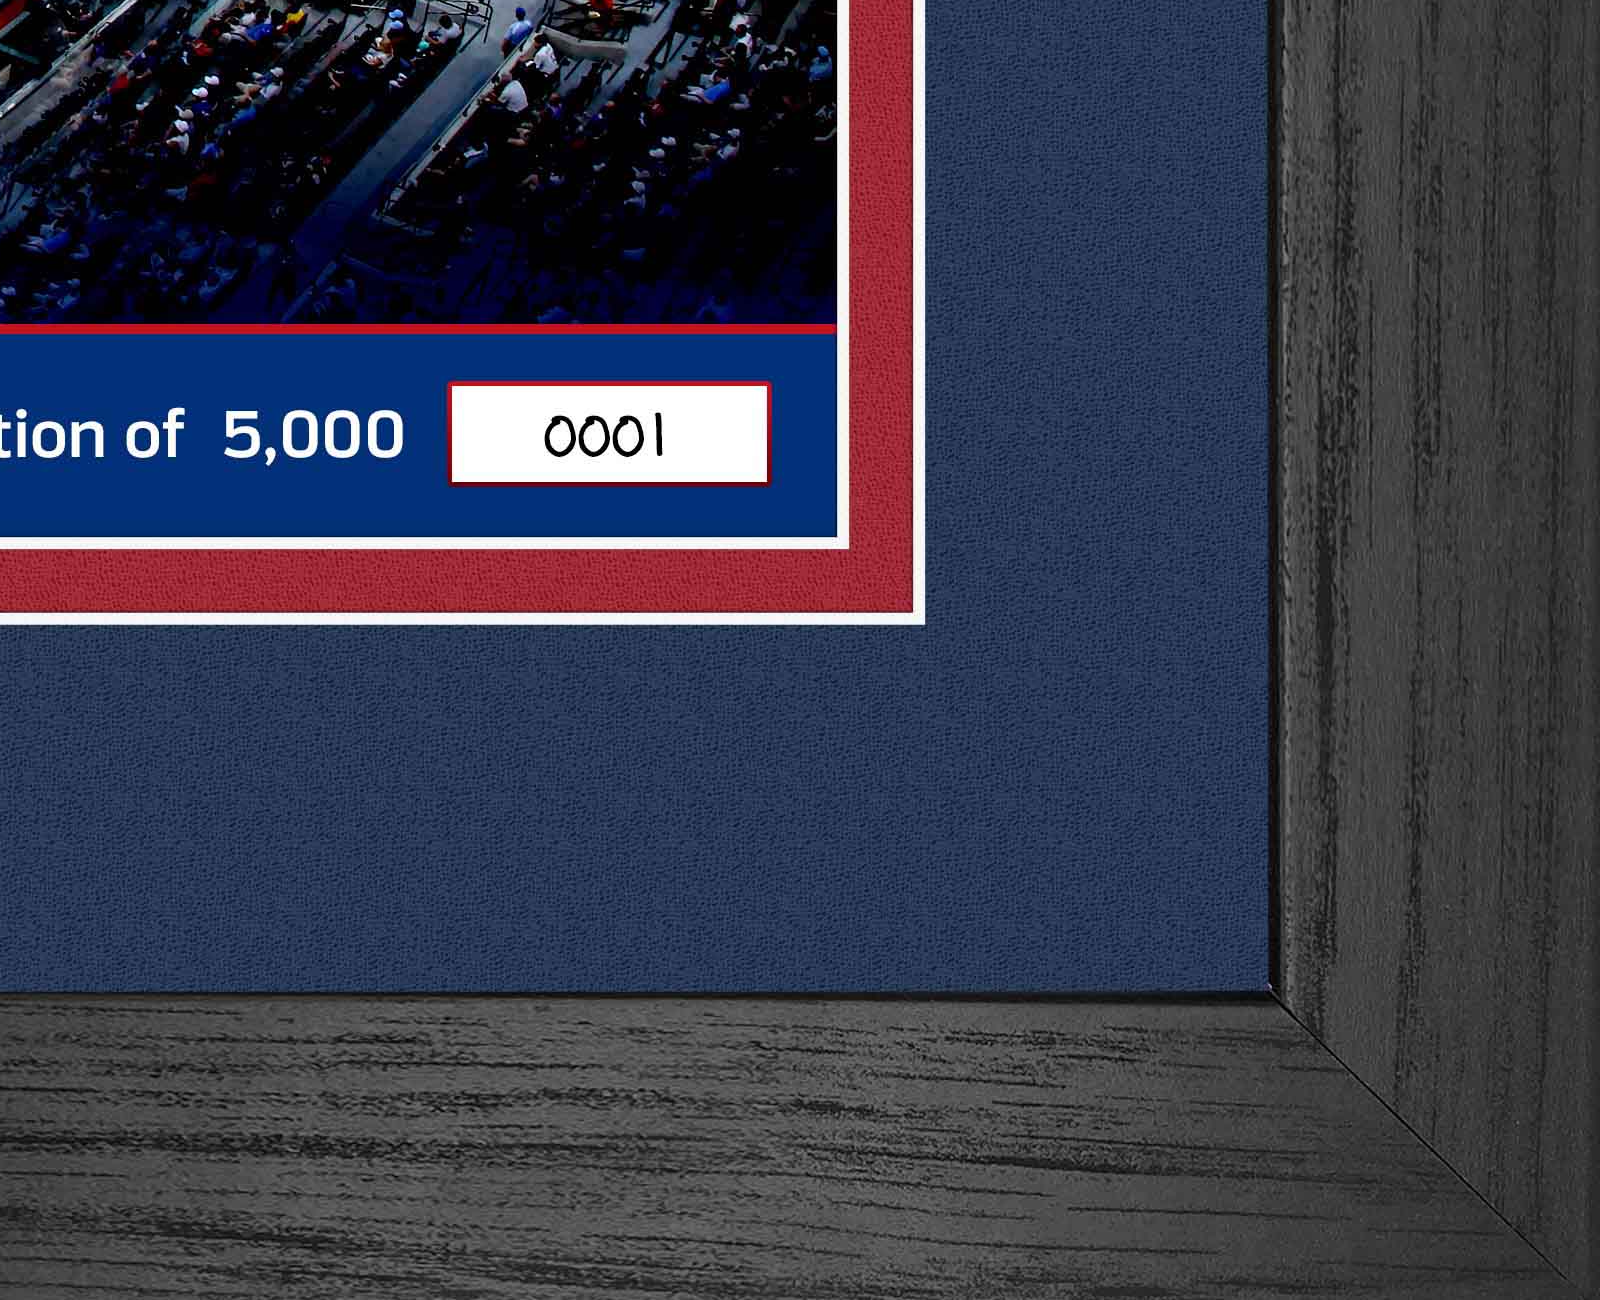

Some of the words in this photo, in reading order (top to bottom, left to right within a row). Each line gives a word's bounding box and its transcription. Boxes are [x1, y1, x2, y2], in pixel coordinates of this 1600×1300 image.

[126, 407, 185, 459] of
[224, 409, 404, 466] 5,000
[544, 412, 663, 458] 0001
